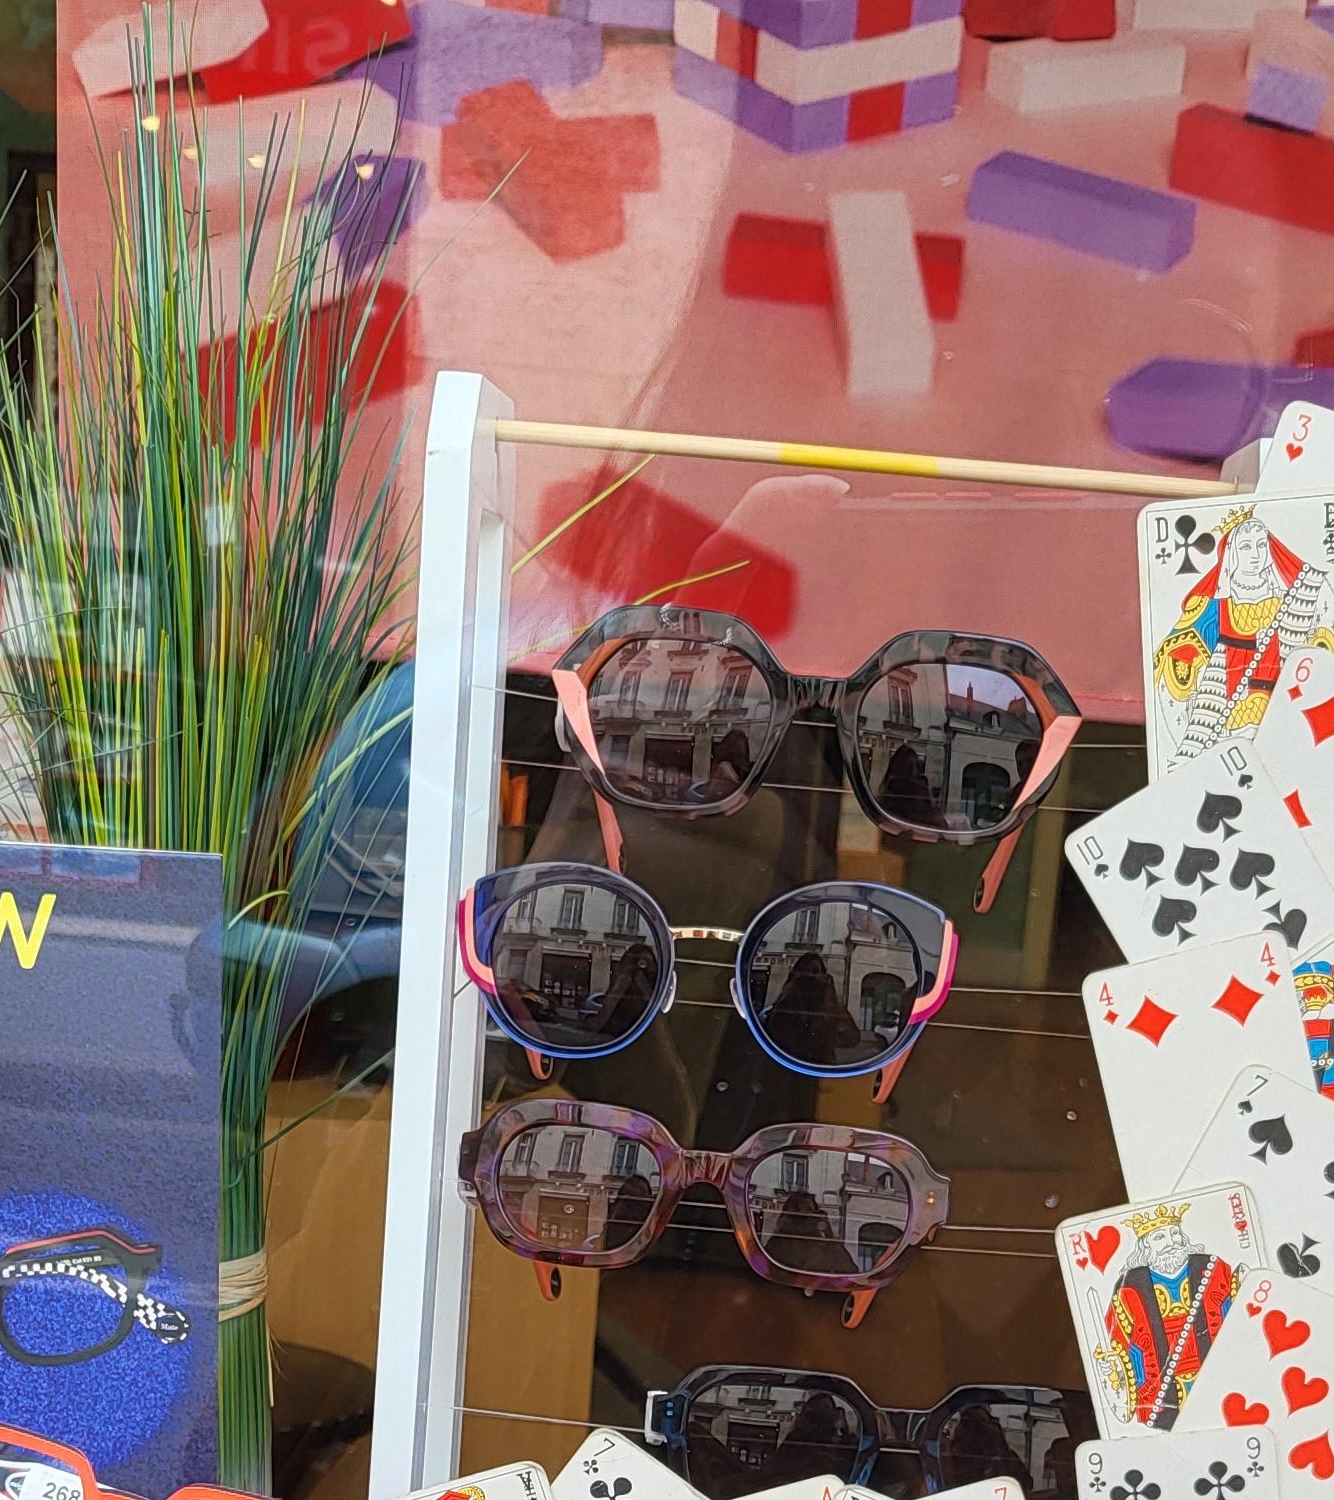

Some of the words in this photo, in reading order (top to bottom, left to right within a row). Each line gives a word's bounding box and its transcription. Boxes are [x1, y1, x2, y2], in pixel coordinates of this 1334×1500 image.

[1292, 413, 1313, 443] 3
[1155, 517, 1170, 543] D
[1294, 656, 1314, 683] 6
[1219, 745, 1248, 777] 10
[1075, 836, 1104, 866] 10
[1260, 942, 1277, 968] 4
[1098, 982, 1115, 1008] 4
[1247, 1074, 1269, 1097] 7
[1068, 1231, 1087, 1256] R
[1252, 1278, 1273, 1304] 8
[593, 1436, 616, 1457] 7
[1246, 1435, 1262, 1461] 9
[1087, 1451, 1104, 1475] 9
